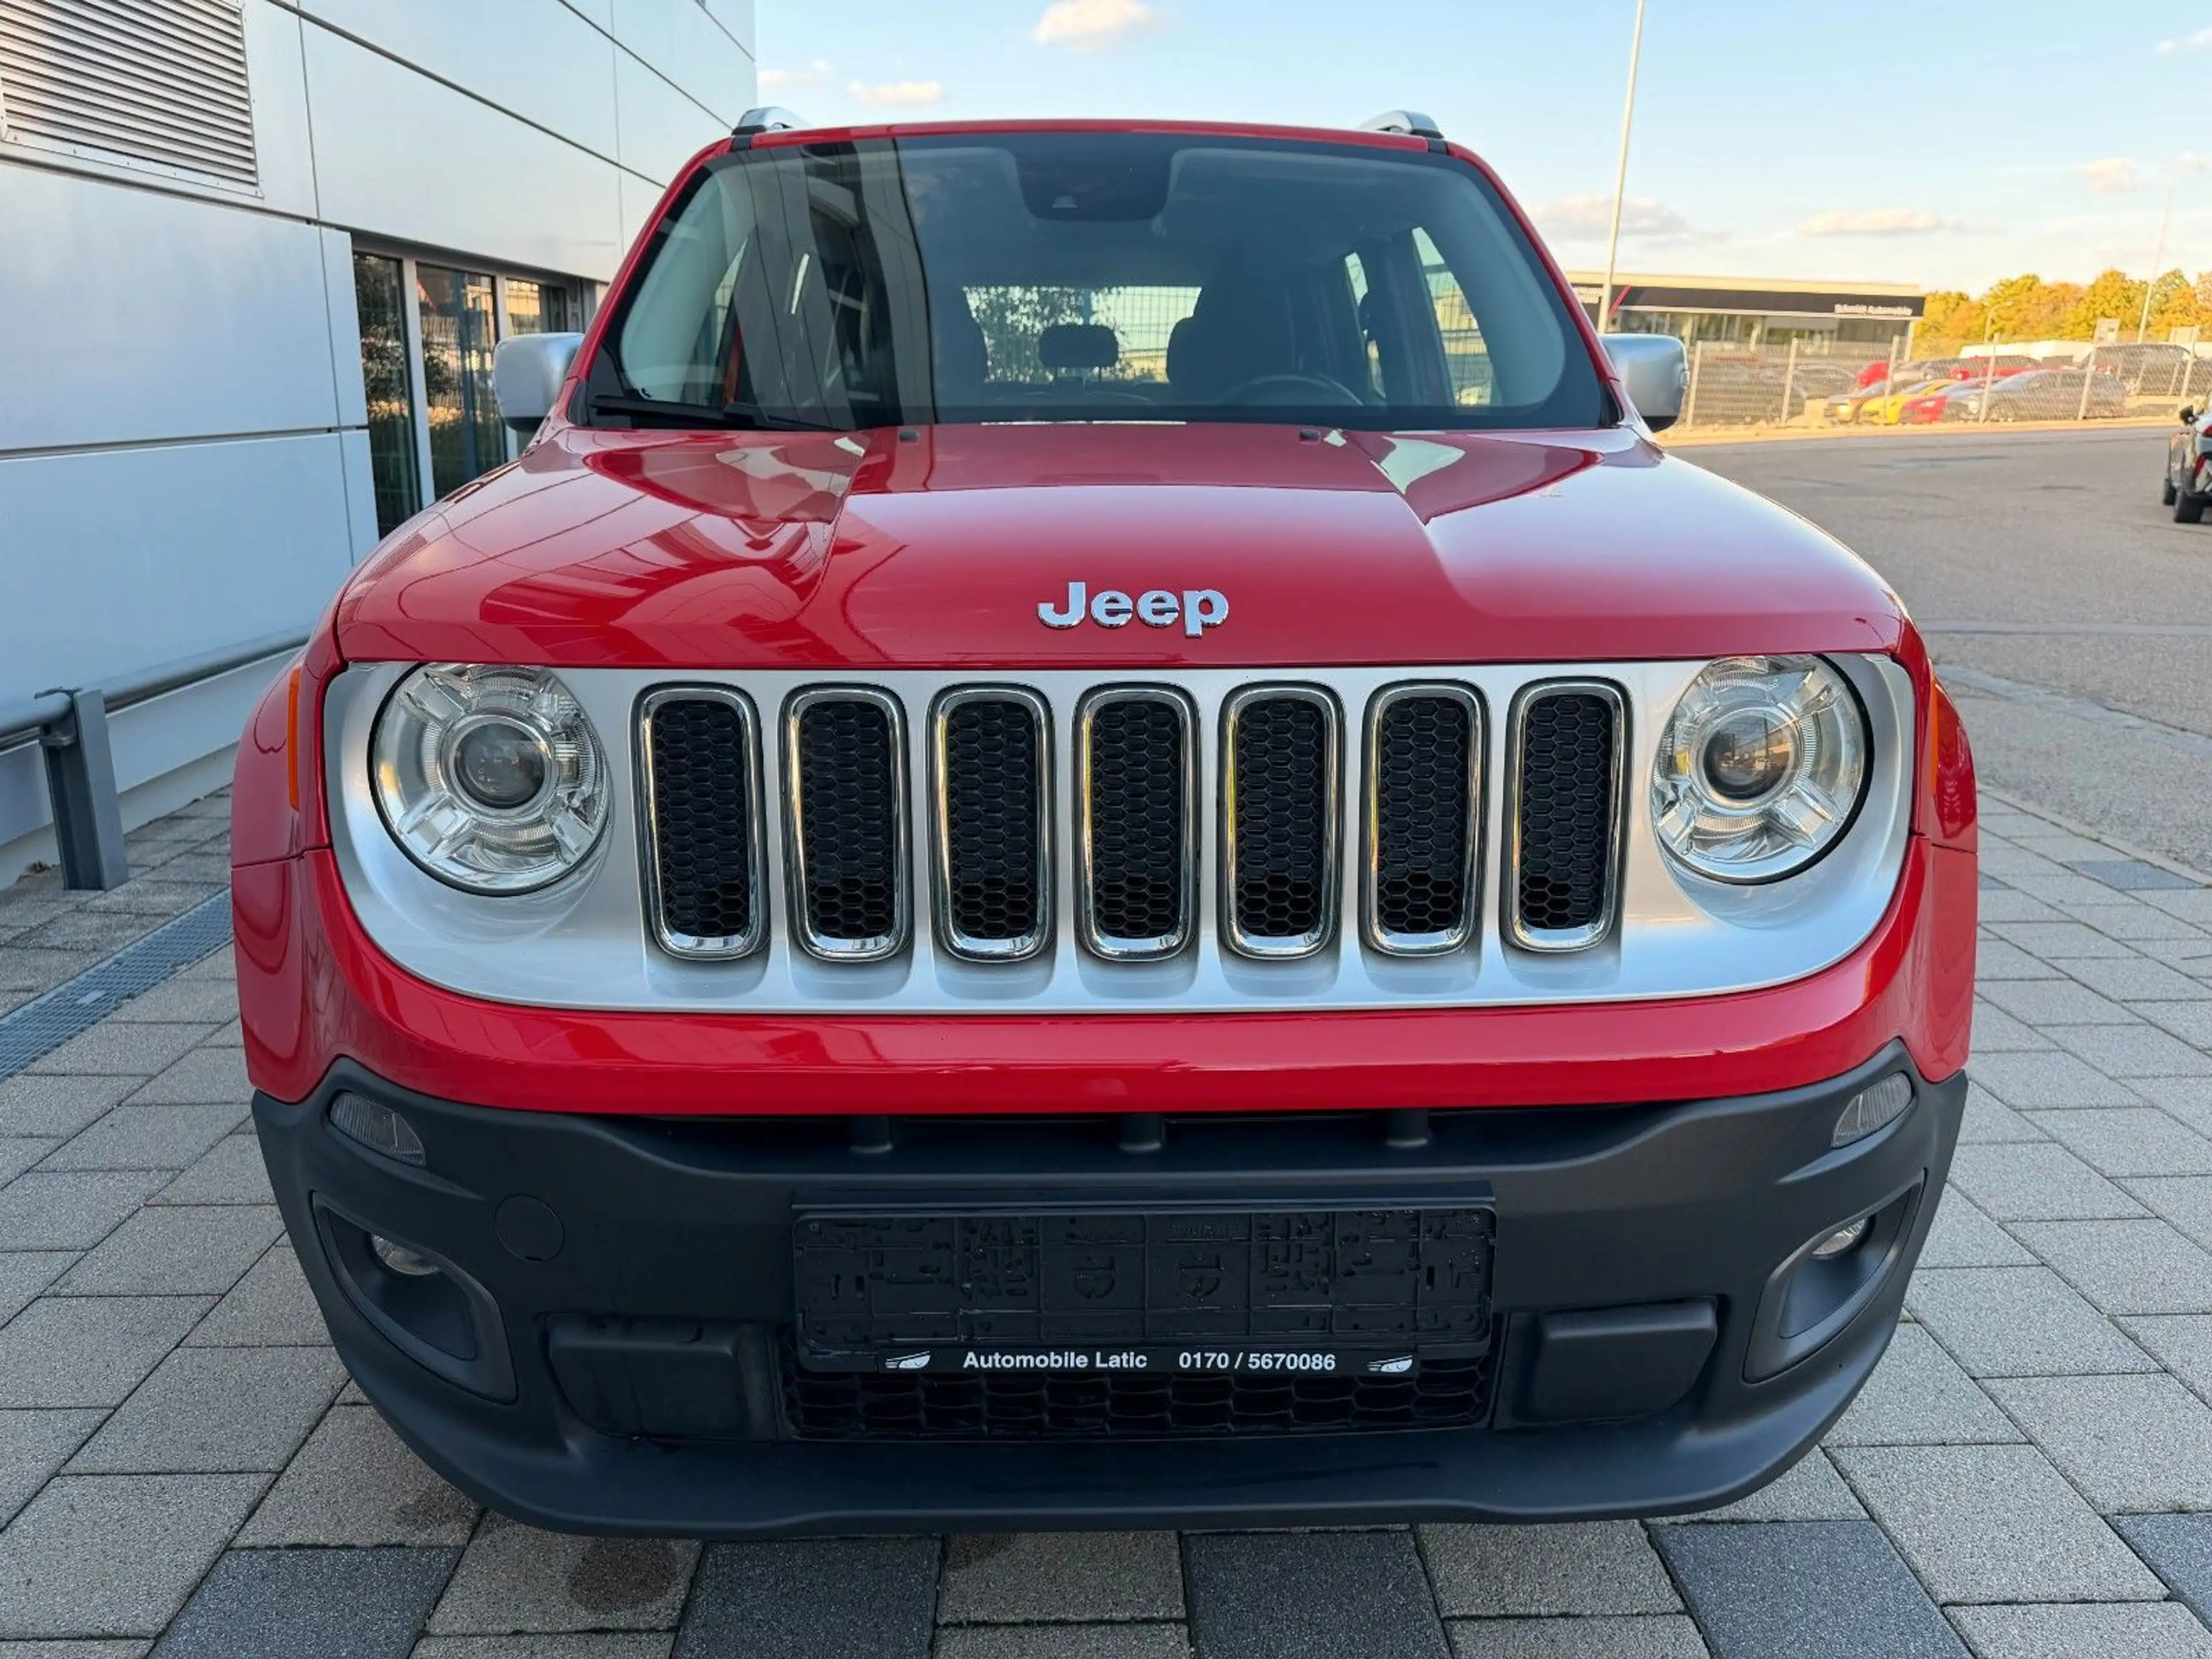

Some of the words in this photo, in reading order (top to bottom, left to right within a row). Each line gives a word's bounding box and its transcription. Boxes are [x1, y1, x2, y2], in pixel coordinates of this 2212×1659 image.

[1037, 581, 1229, 638] Jeep
[963, 1351, 1089, 1369] Automobile
[1095, 1351, 1148, 1369] Latic
[1179, 1351, 1230, 1369] 0170
[1234, 1351, 1244, 1370] /
[1248, 1353, 1336, 1370] 5670086
